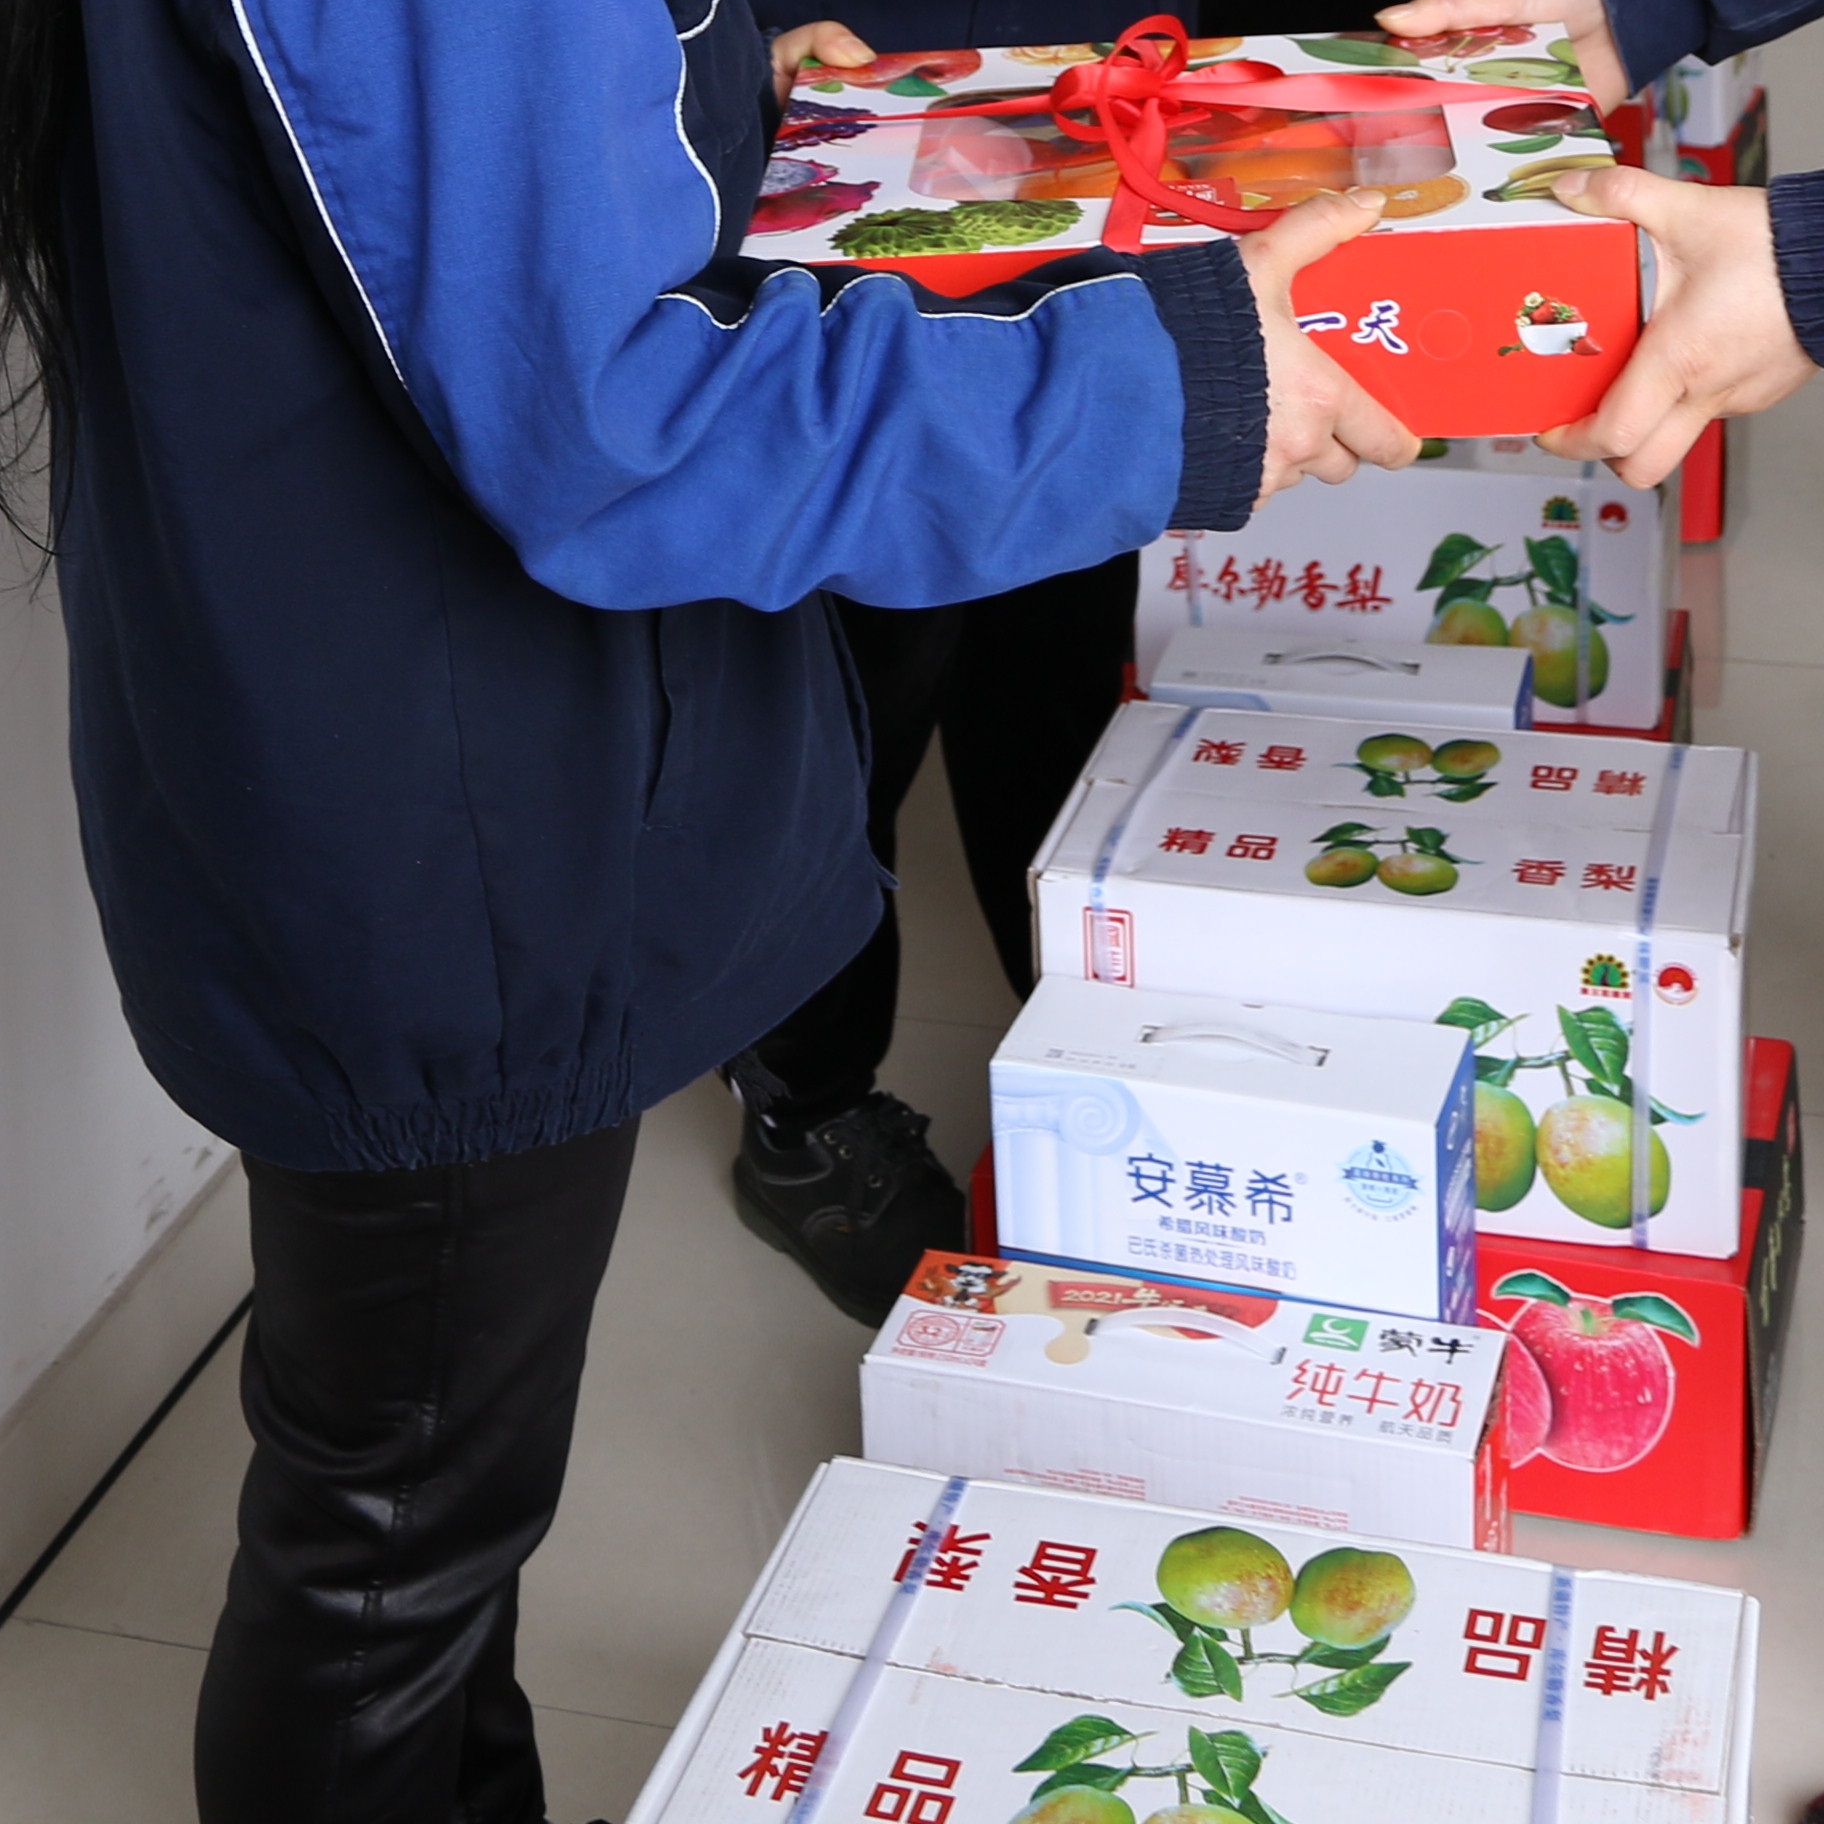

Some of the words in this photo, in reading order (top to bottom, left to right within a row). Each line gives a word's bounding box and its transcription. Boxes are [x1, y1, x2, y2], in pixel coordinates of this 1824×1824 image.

[1158, 827, 1279, 861] 精品
[1511, 858, 1637, 893] 香梨
[1126, 1152, 1295, 1225] 安慕希
[1158, 1214, 1268, 1247] 希腊风味酸奶
[1378, 1328, 1474, 1365] 蒙牛
[1286, 1358, 1463, 1429] 纯牛奶
[893, 1521, 1098, 1611] 香梨
[1463, 1607, 1681, 1701] 精品
[738, 1721, 963, 1824] 精品
